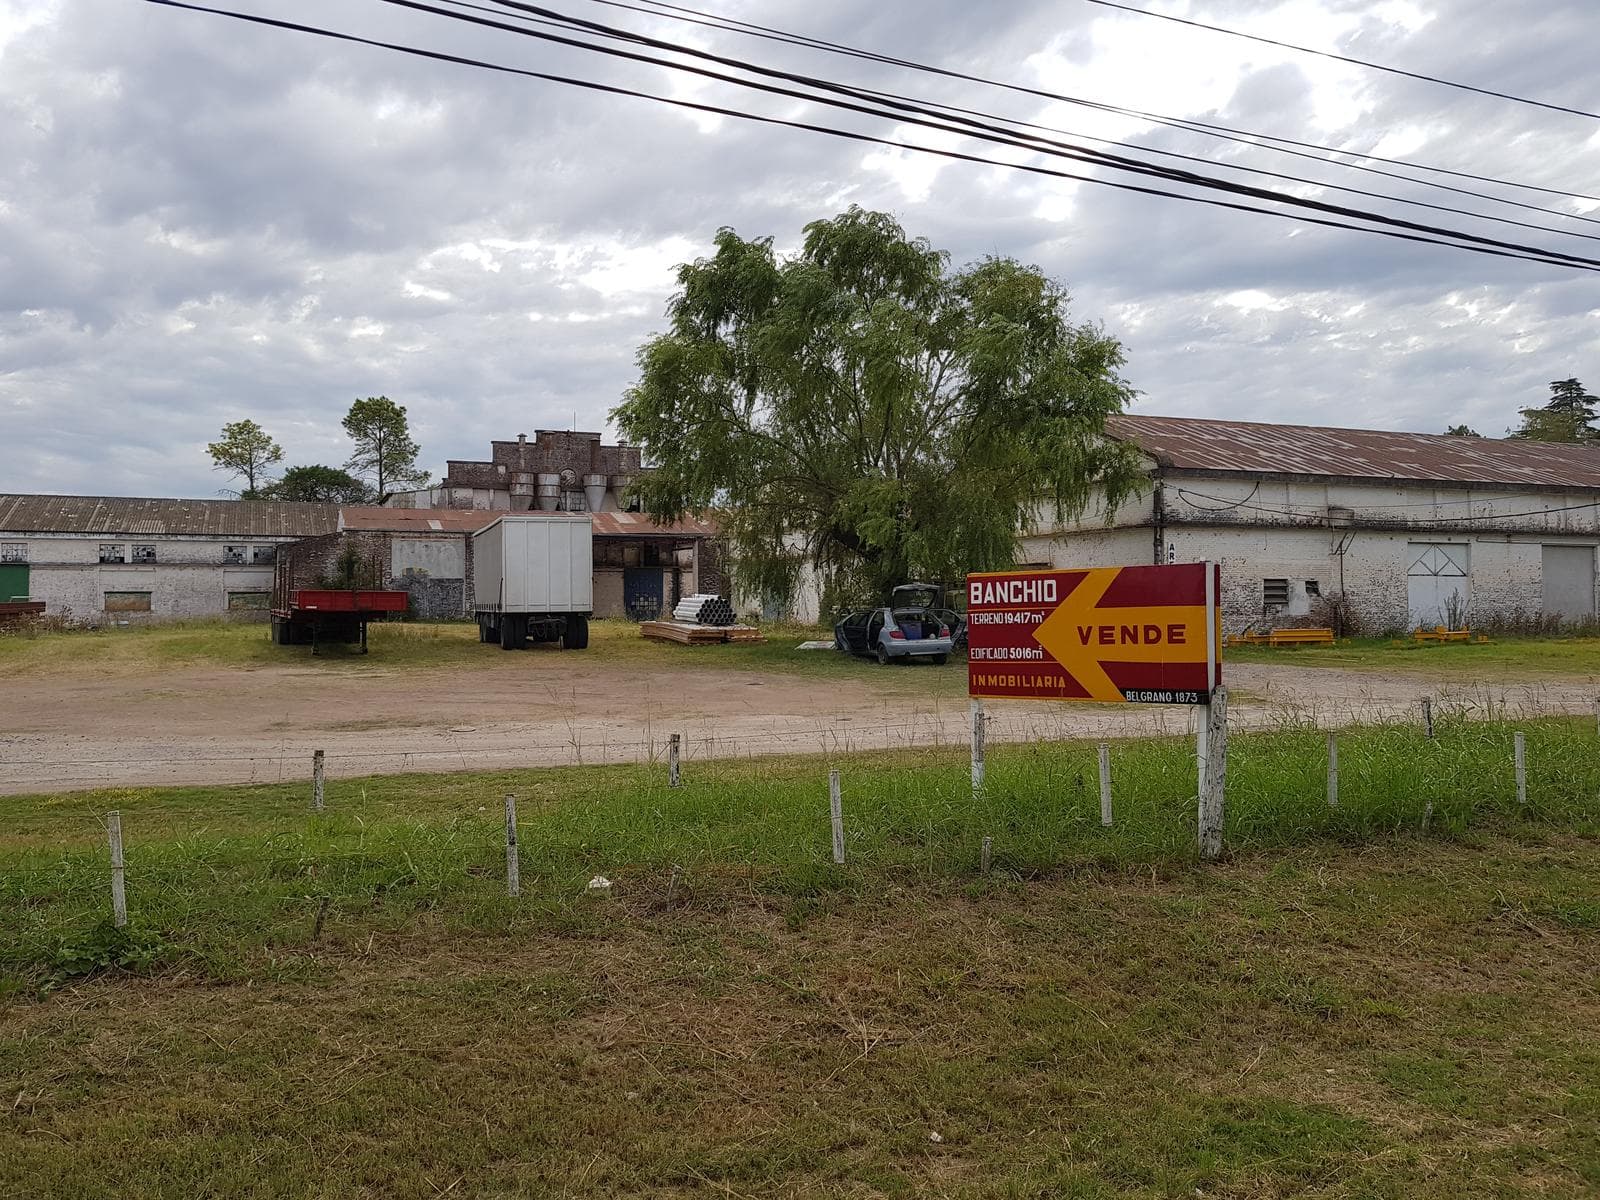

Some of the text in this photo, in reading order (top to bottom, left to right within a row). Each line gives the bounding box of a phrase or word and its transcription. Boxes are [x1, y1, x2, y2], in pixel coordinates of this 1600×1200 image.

[970, 579, 1057, 604] BANCHIO
[970, 612, 1004, 625] TERRENO
[1077, 624, 1186, 646] VENDE
[970, 647, 1008, 660] EDIFICADO
[972, 674, 1066, 688] INMOBILIARIA
[1125, 690, 1198, 703] BELGRANO 1873
